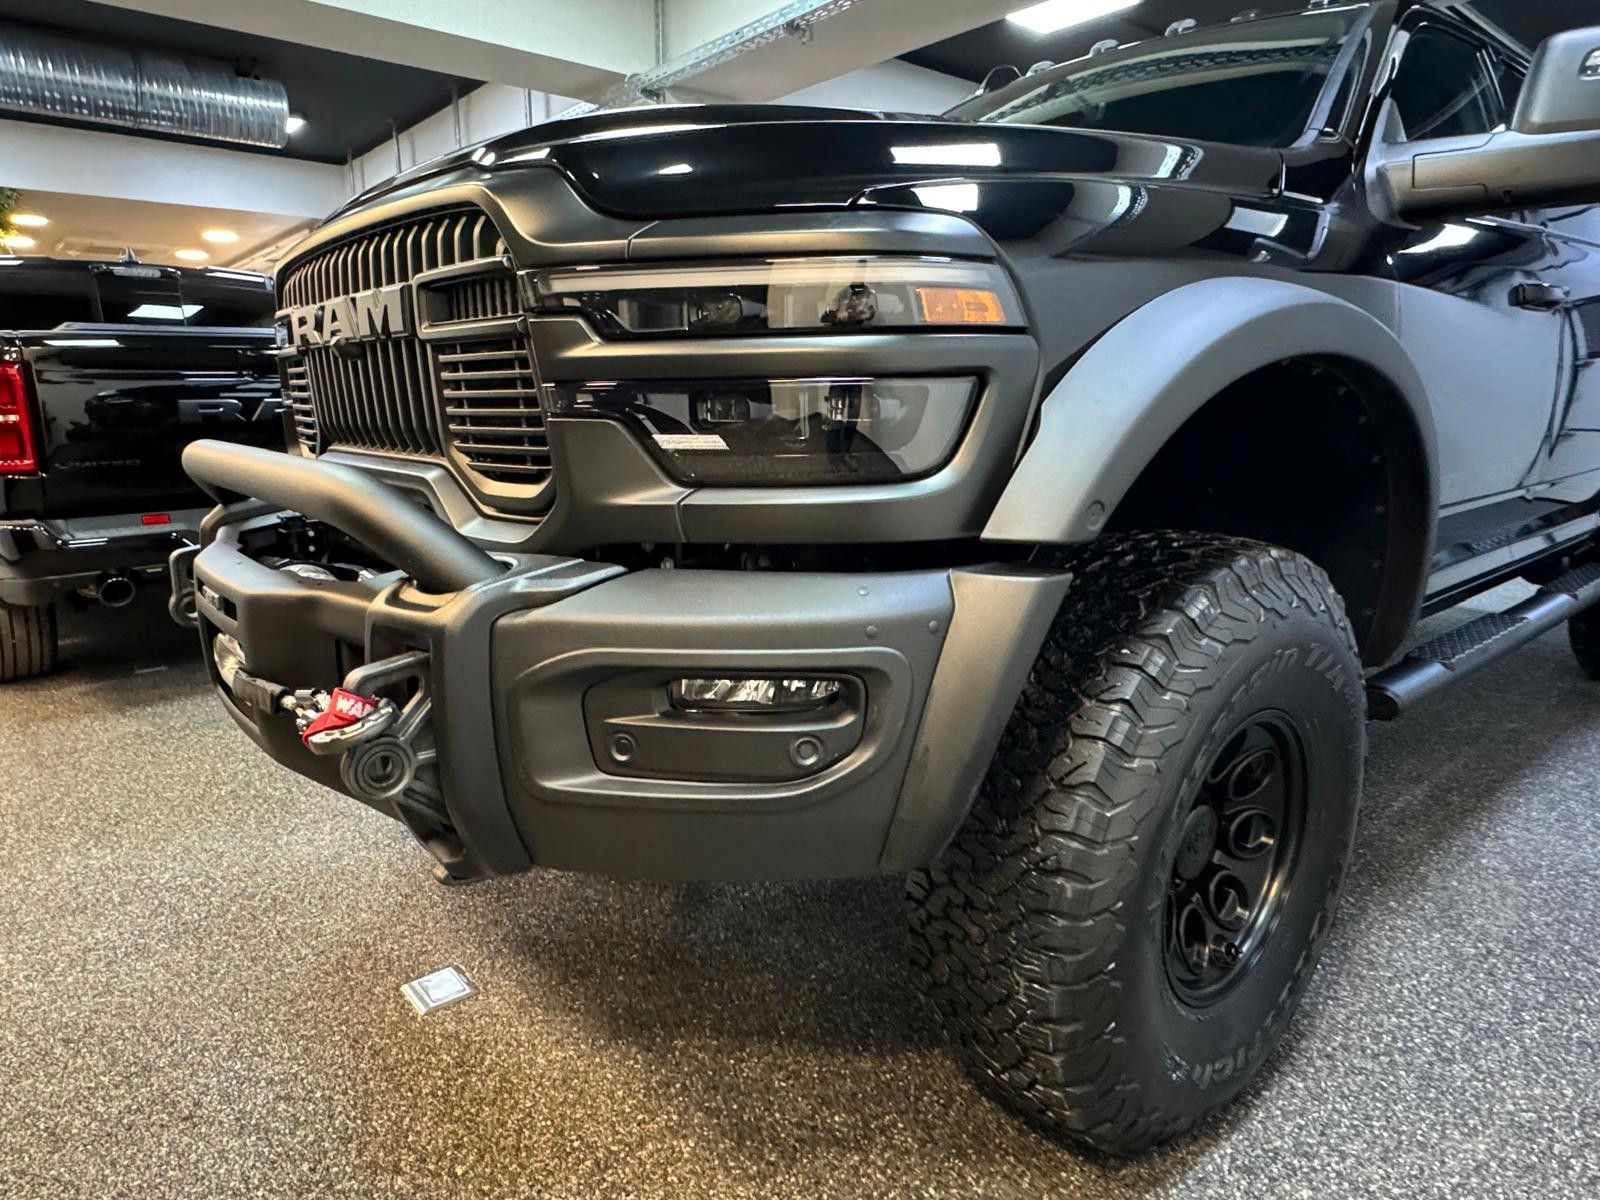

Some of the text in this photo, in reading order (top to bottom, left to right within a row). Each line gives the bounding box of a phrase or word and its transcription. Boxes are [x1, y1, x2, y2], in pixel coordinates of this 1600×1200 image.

[290, 284, 411, 349] RAM
[178, 398, 284, 424] RA
[335, 694, 374, 718] WA
